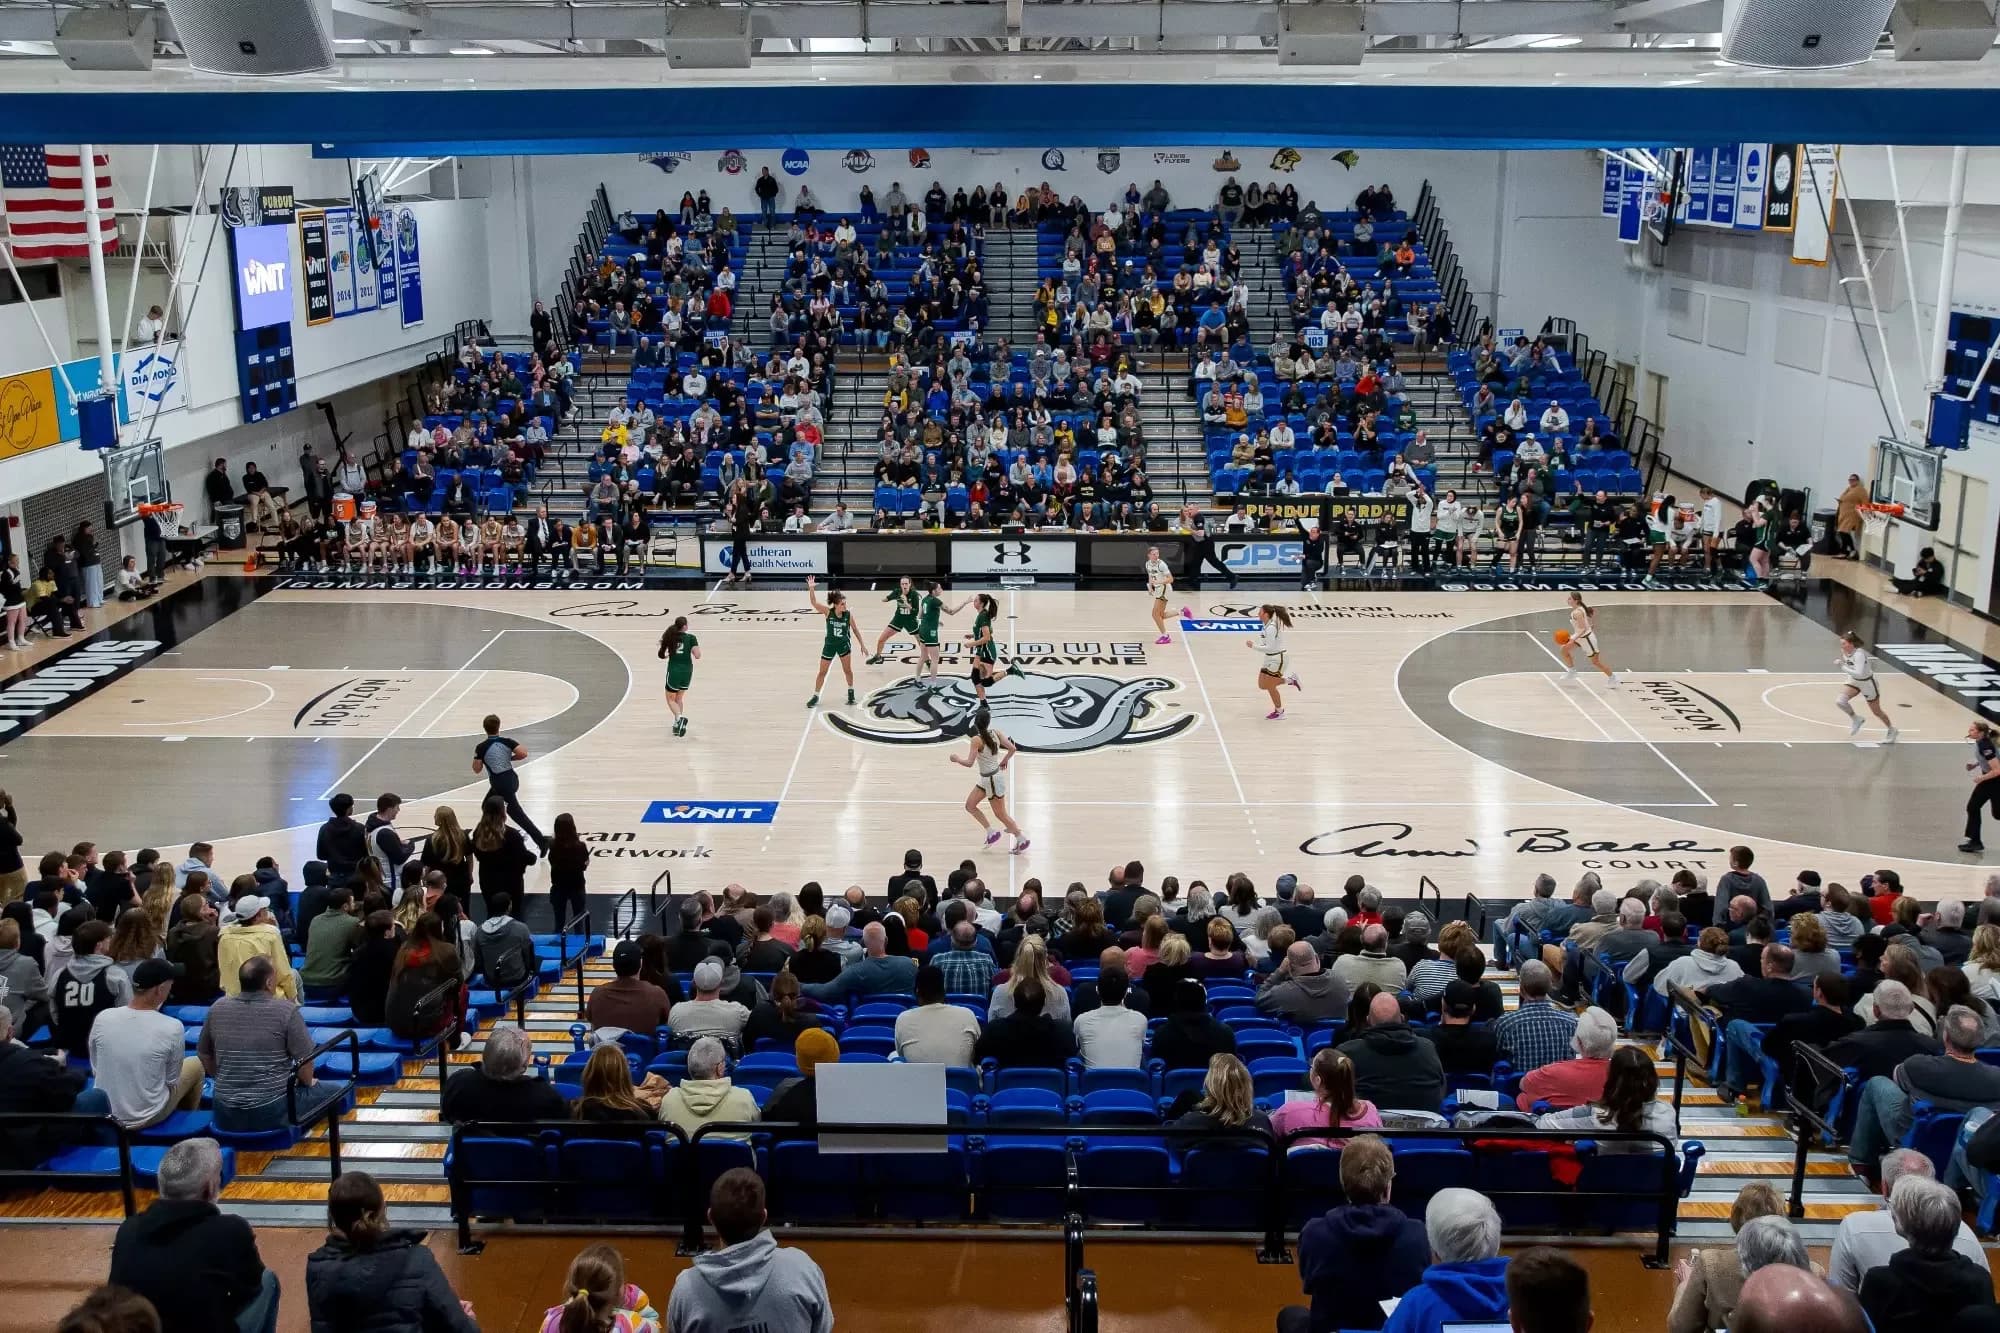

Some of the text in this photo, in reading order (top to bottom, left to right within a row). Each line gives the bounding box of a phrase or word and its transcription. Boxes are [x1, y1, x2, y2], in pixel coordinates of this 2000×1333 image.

[785, 161, 809, 169] NCAA
[262, 195, 293, 208] PURDUE
[306, 256, 326, 275] WNIT
[243, 258, 286, 296] WNIT
[337, 289, 352, 302] 2014
[360, 286, 373, 298] 2011
[312, 295, 328, 309] 2024
[1308, 337, 1323, 347] 103
[1503, 337, 1517, 347] 10
[131, 367, 177, 386] DIAMOND
[749, 545, 792, 556] utheran
[775, 560, 814, 568] Network
[1286, 604, 1393, 612] utheran
[833, 628, 844, 637] 12
[1192, 622, 1264, 631] WNIT
[308, 679, 390, 726] HORIZON
[343, 678, 414, 727] LEAGUE
[1619, 681, 1691, 733] LEAGUE
[1641, 681, 1727, 731] HORIZON
[662, 806, 762, 819] WNIT
[1581, 860, 1709, 870] COURT
[65, 981, 95, 1007] 20
